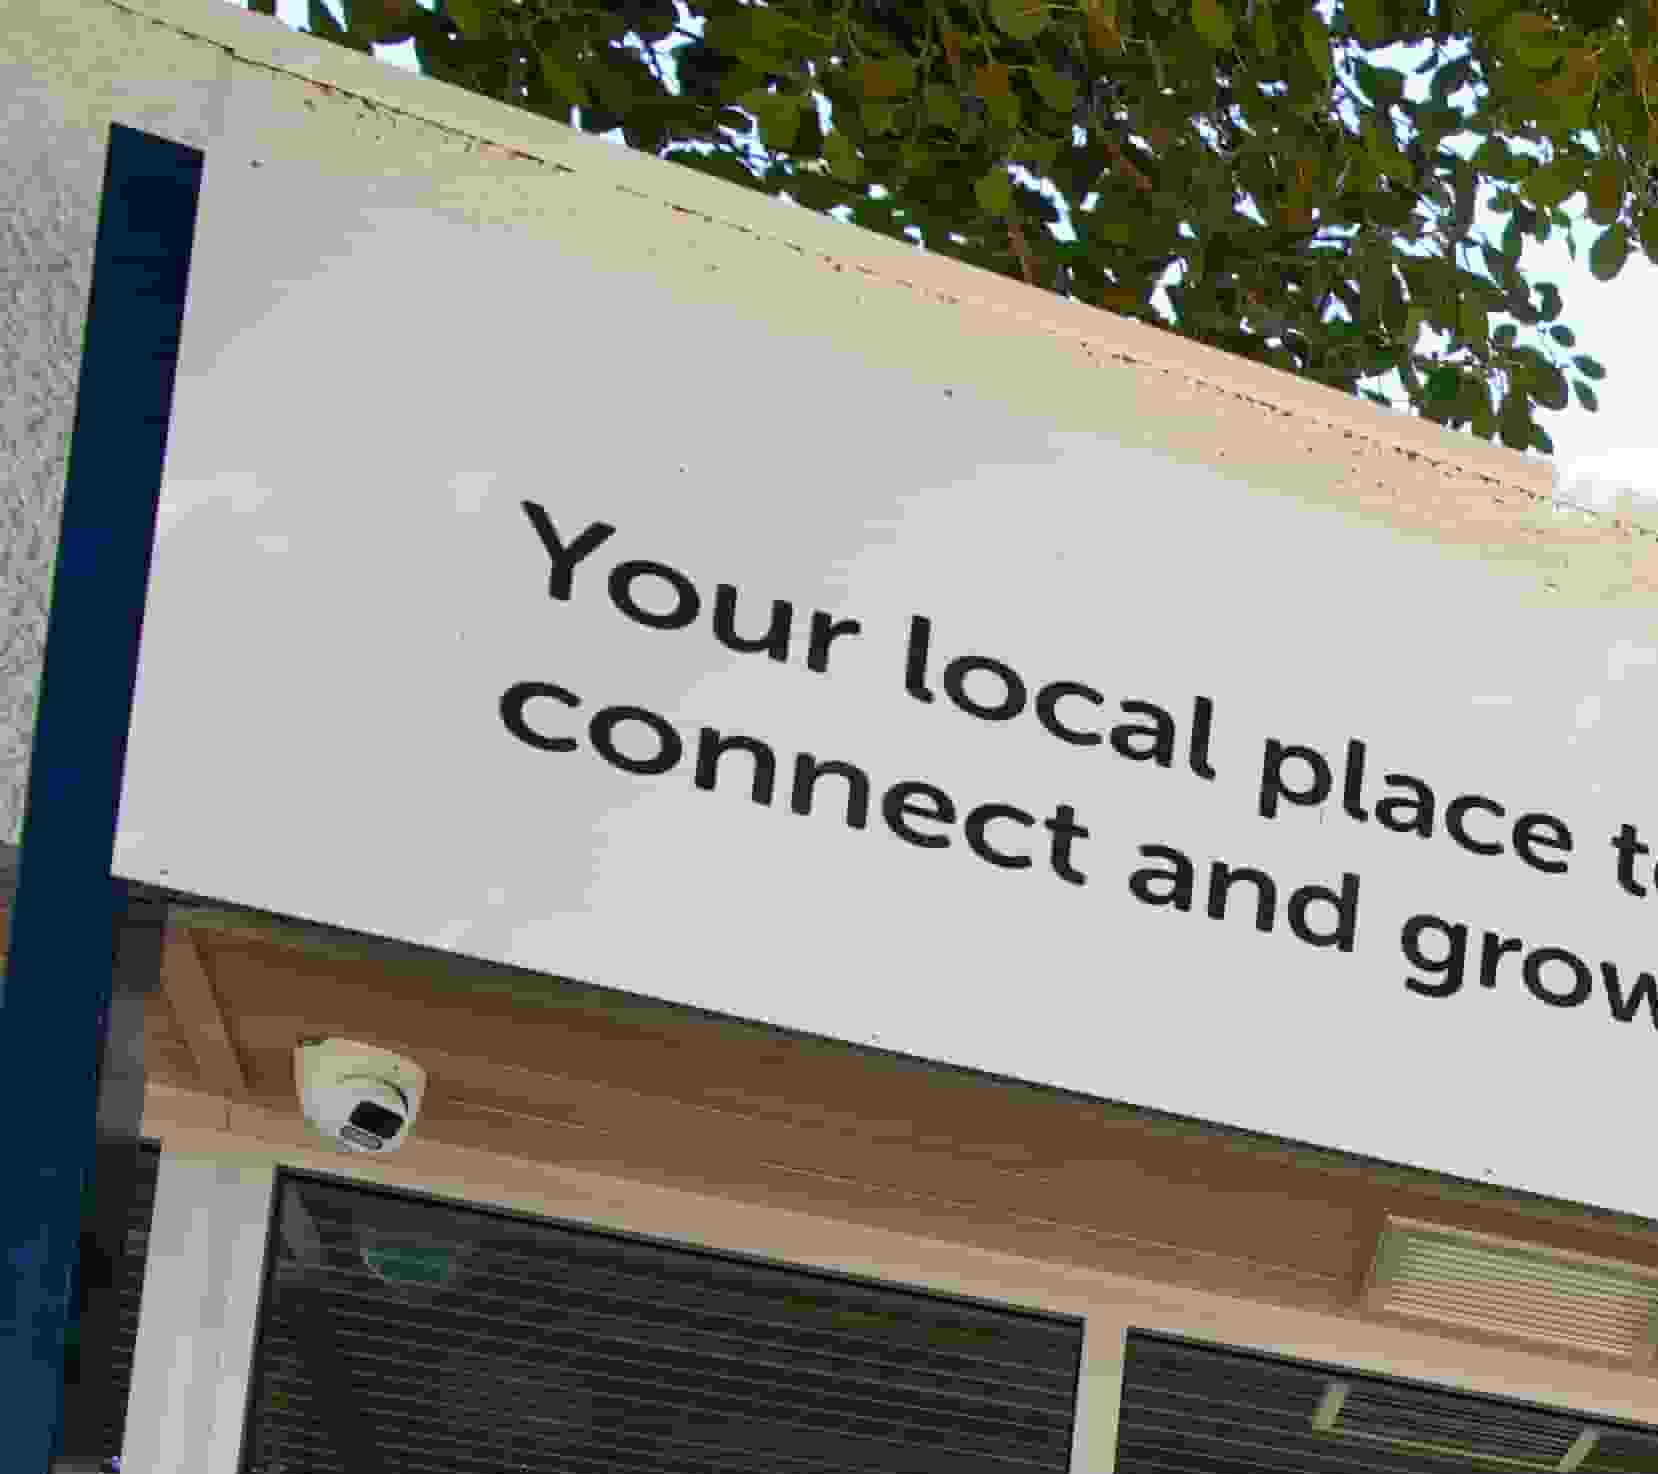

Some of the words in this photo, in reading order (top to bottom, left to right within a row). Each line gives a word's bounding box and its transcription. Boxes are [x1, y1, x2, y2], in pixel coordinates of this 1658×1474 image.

[499, 681, 1089, 886] connect
[1128, 844, 1361, 953] and
[519, 500, 861, 673] Your
[905, 615, 1217, 781] local
[1259, 738, 1573, 874] place
